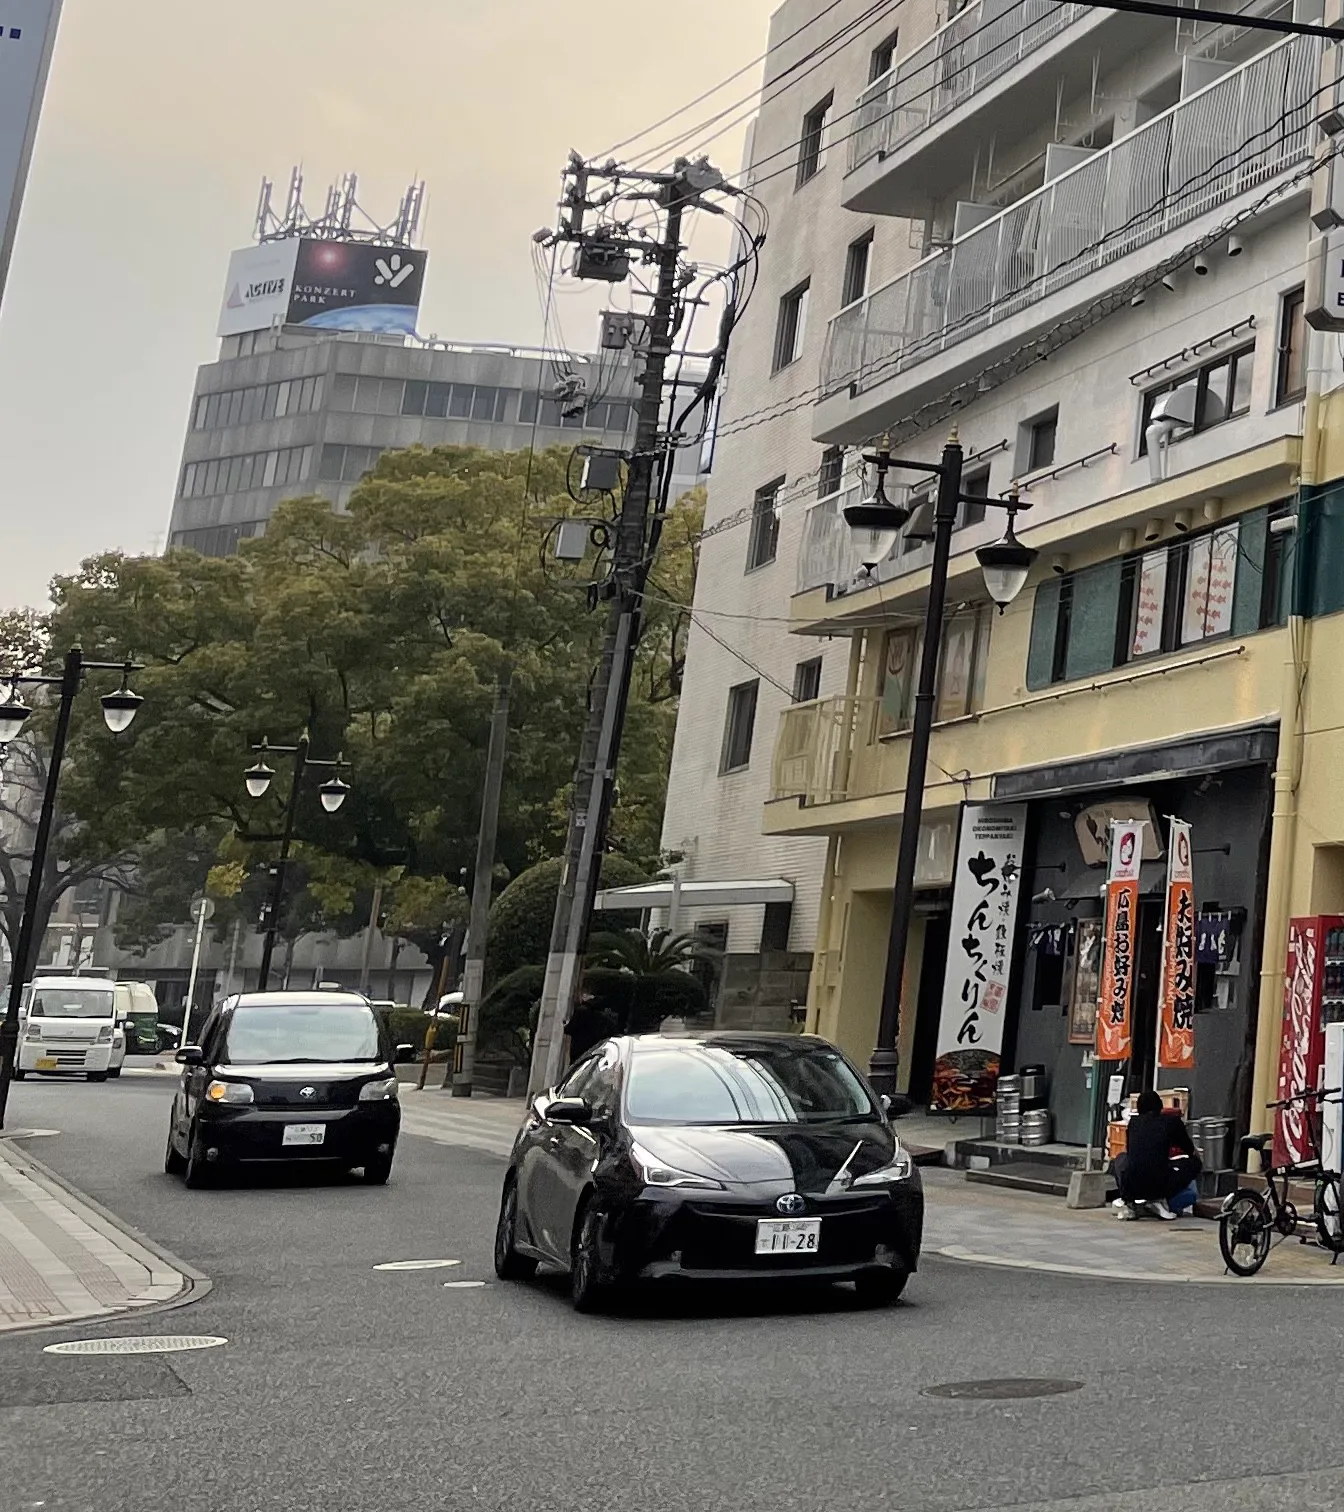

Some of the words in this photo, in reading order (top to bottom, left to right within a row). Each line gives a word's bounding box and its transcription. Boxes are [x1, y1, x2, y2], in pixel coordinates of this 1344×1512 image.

[293, 293, 326, 304] PARK
[956, 850, 1001, 1045] ちんちくりん
